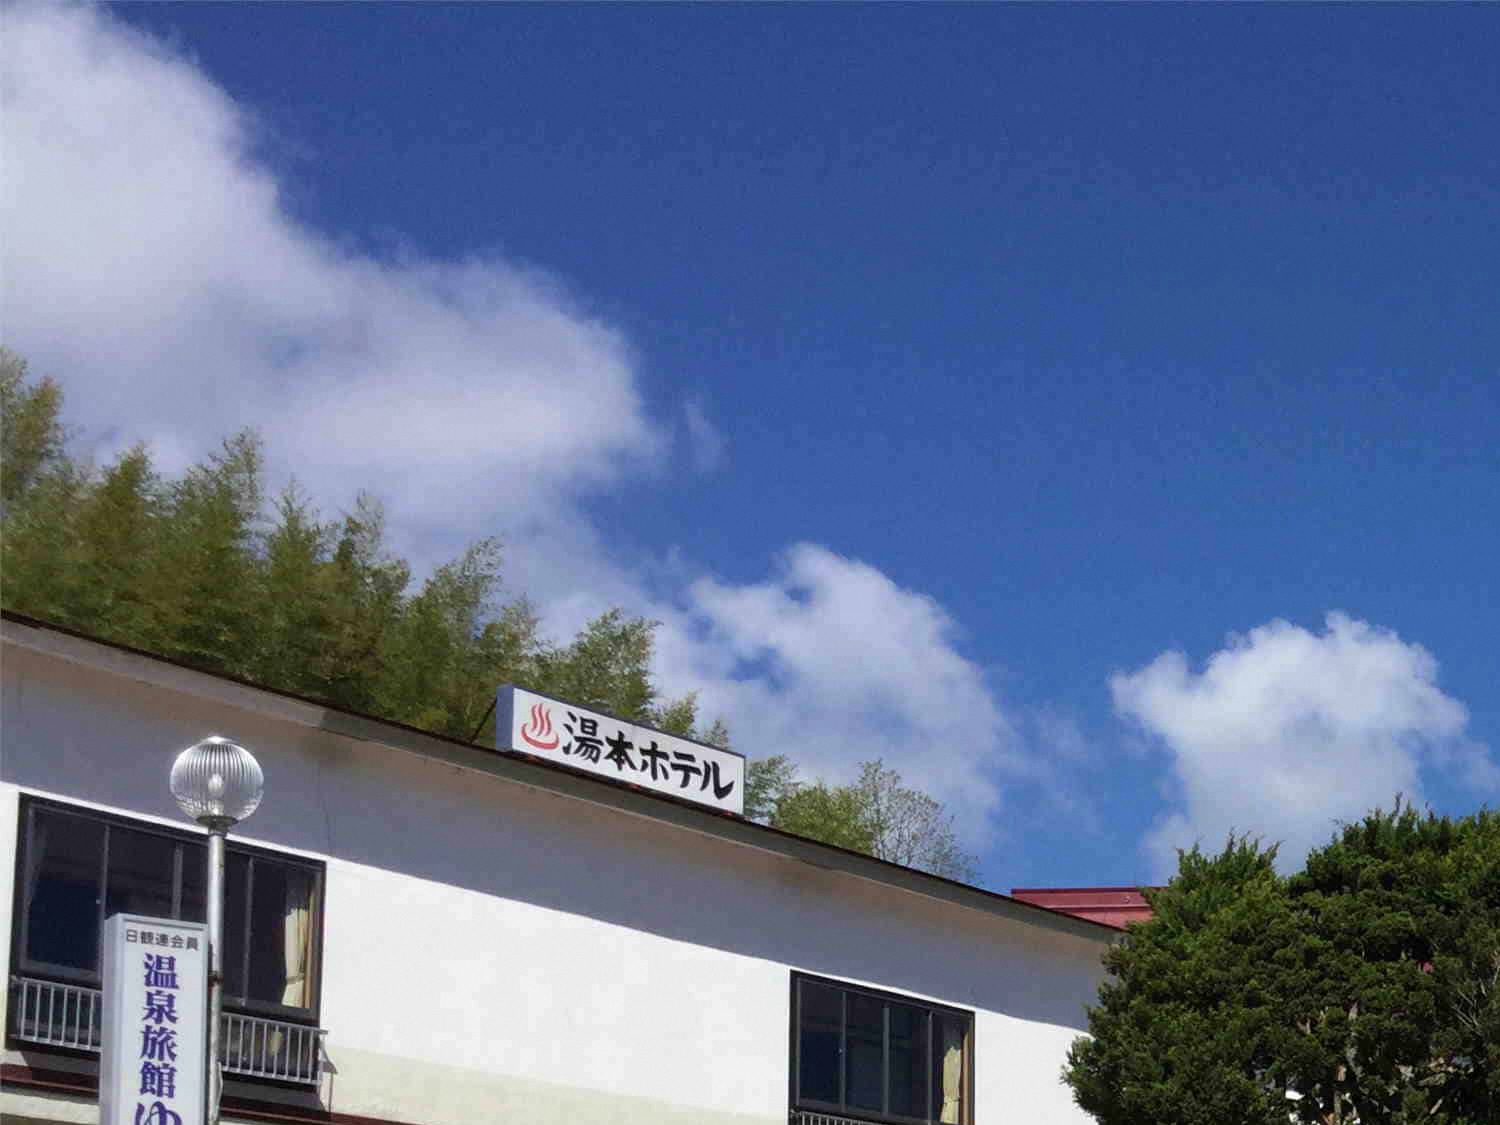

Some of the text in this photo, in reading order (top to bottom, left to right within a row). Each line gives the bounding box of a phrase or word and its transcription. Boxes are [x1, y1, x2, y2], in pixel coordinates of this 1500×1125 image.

[562, 711, 734, 800] 湯本ホテル
